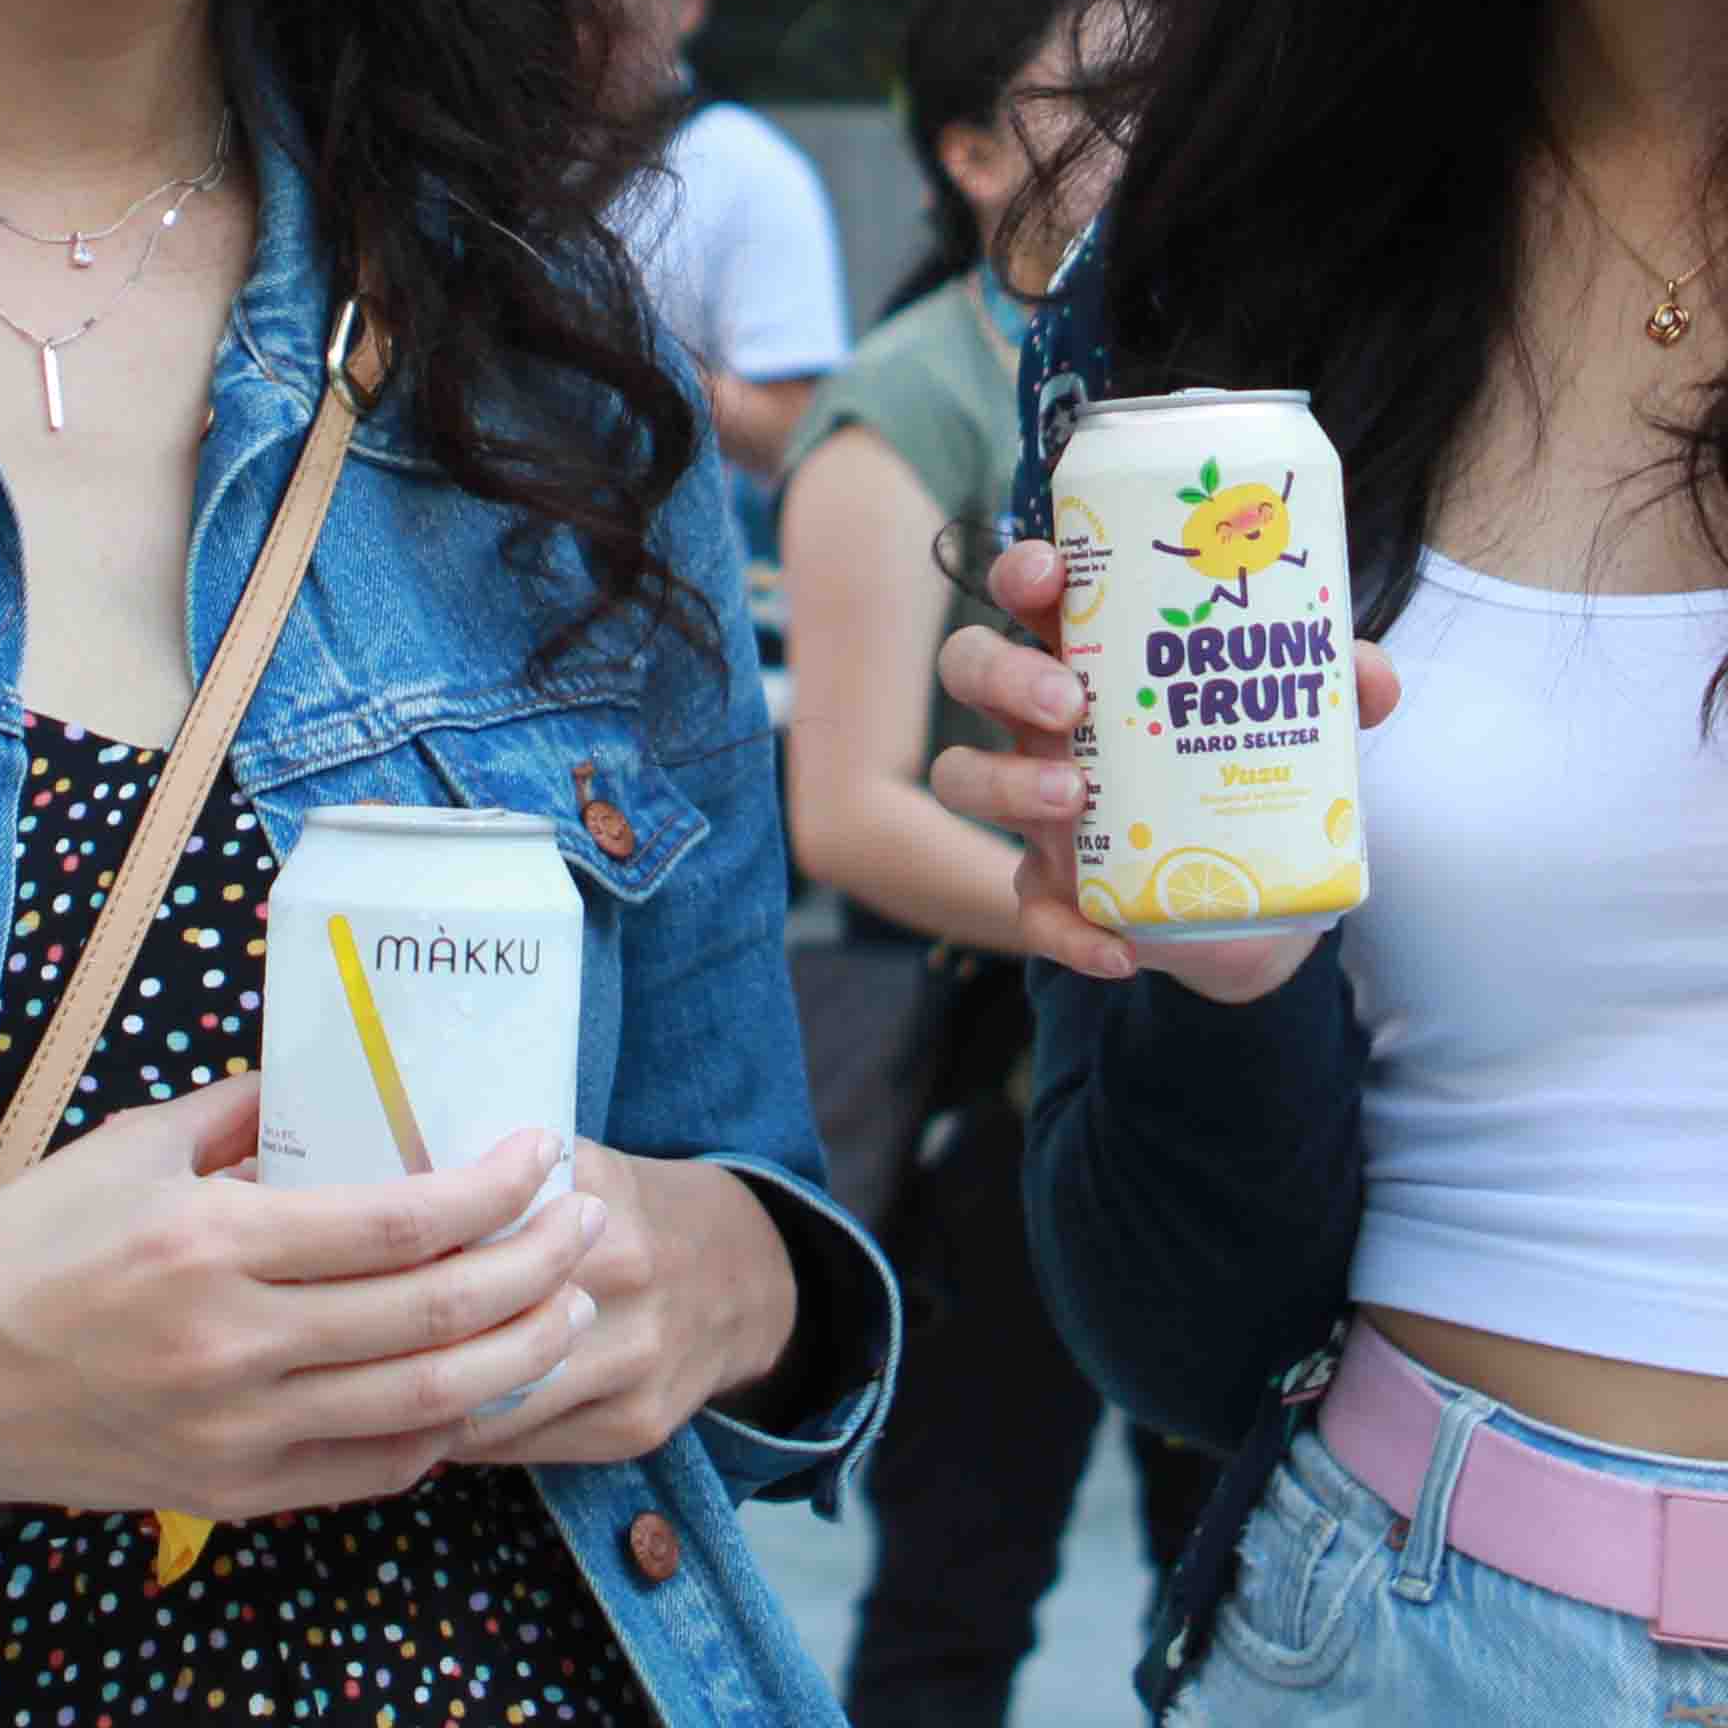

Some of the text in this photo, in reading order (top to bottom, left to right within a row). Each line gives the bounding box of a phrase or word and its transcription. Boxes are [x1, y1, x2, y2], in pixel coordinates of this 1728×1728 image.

[1146, 616, 1337, 678] DRUNK
[1167, 672, 1324, 729] FRUIT
[1176, 728, 1320, 754] HARD SELTZER
